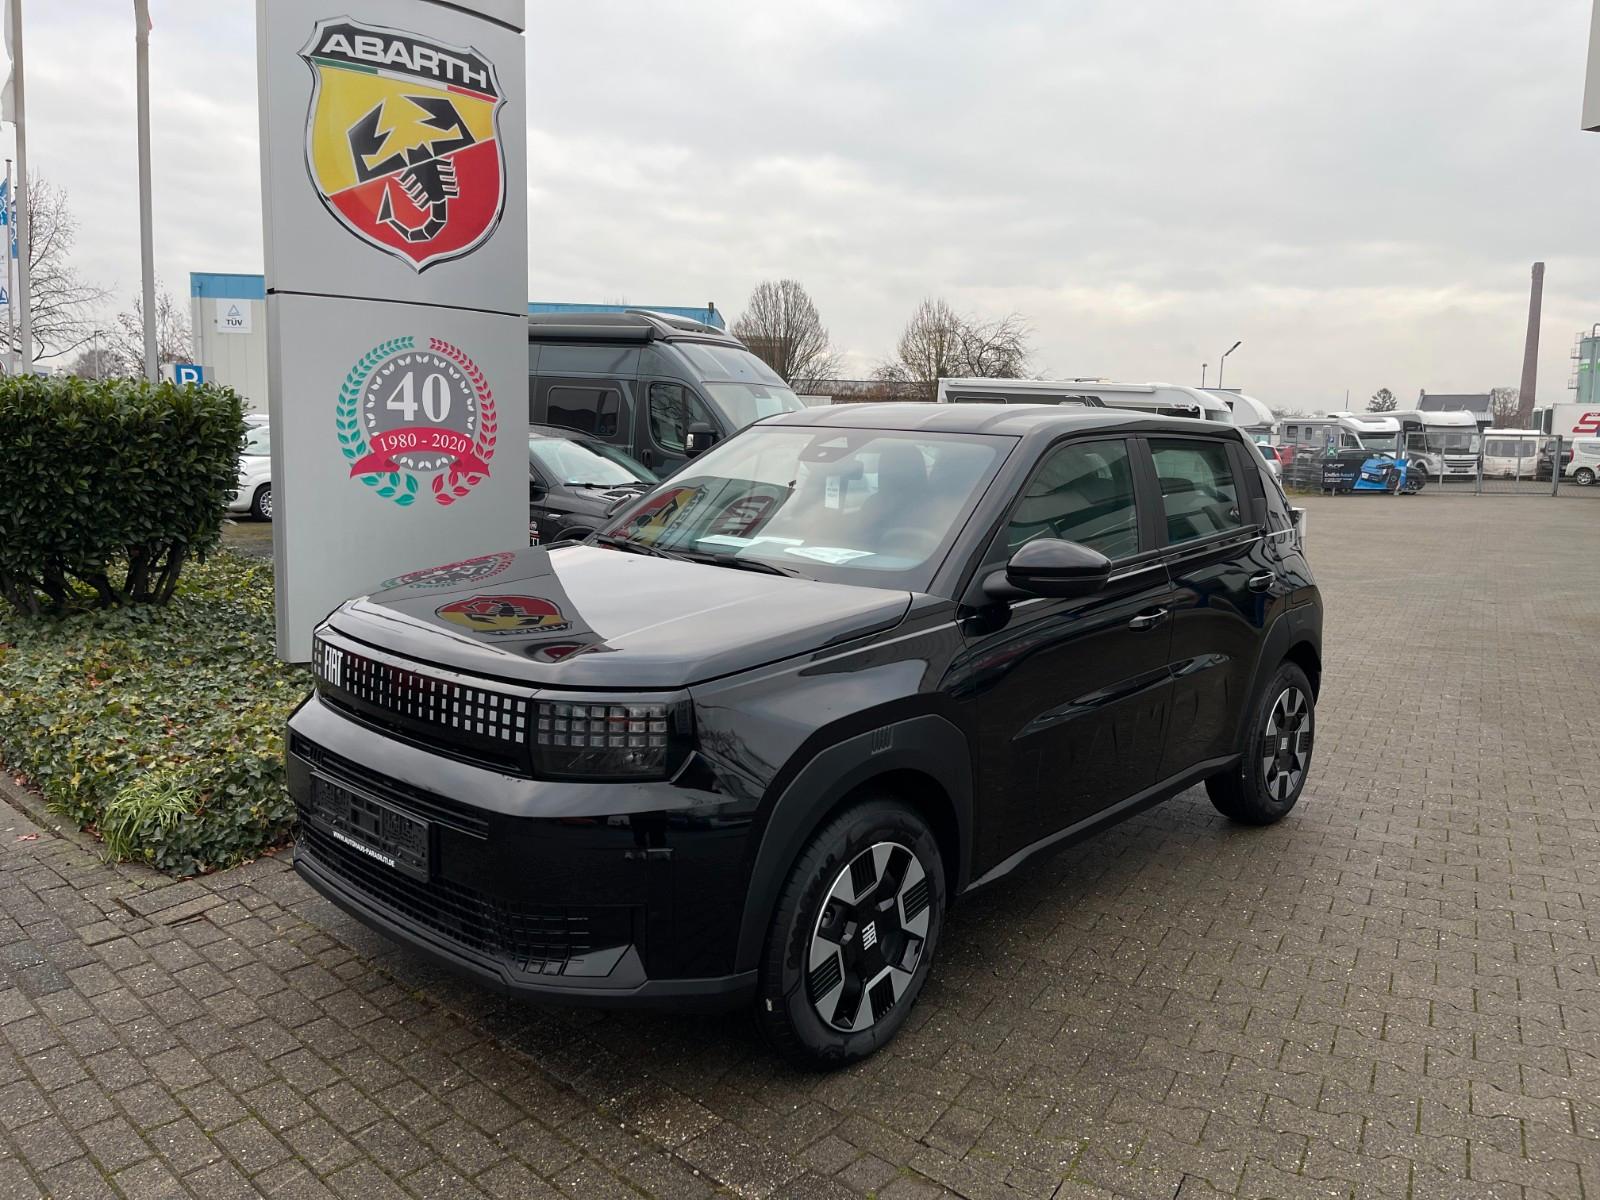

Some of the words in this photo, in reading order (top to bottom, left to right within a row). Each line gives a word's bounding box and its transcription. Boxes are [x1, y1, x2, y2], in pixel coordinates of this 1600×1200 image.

[320, 33, 487, 89] ABARTH
[226, 317, 243, 326] TÜV
[180, 367, 199, 385] P
[386, 371, 451, 423] 40
[379, 432, 417, 452] 1980
[431, 433, 467, 453] 2020
[324, 644, 343, 687] FIAT
[862, 920, 878, 950] FIAT
